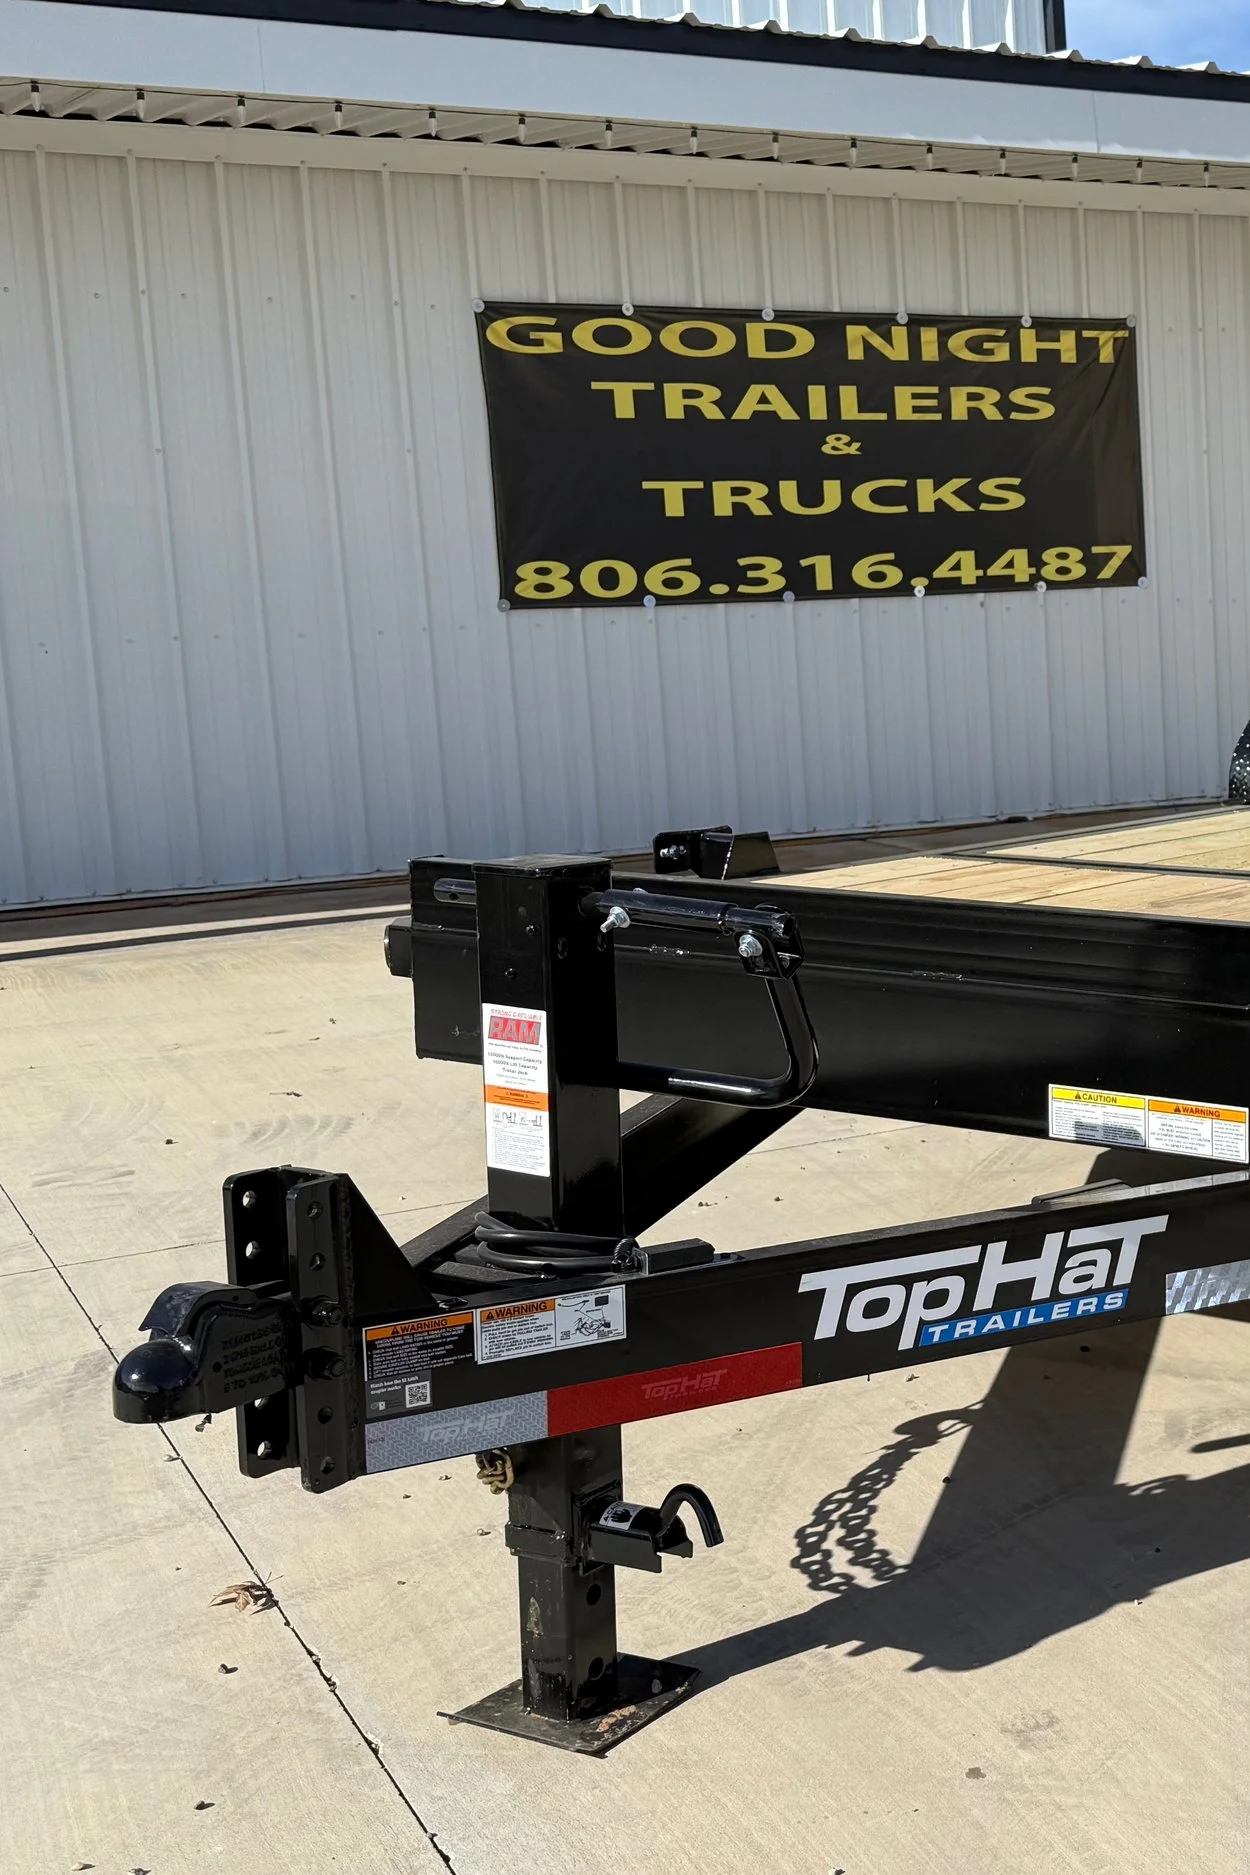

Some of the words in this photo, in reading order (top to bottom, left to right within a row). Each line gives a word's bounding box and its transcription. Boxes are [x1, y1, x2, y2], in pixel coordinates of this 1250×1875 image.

[486, 316, 815, 359] GOOD
[847, 325, 1128, 364] NIGHT
[590, 381, 1056, 421] TRAILERS
[820, 433, 862, 455] &
[642, 477, 1026, 517] TRUCKS
[514, 545, 1133, 599] 806.316.4487
[488, 1015, 541, 1046] RAM
[1081, 1092, 1118, 1104] CAUTION
[1181, 1105, 1221, 1118] WARNING
[495, 1301, 548, 1317] WARNING
[927, 1292, 1124, 1342] TRAILERS
[400, 1318, 448, 1334] WARNING
